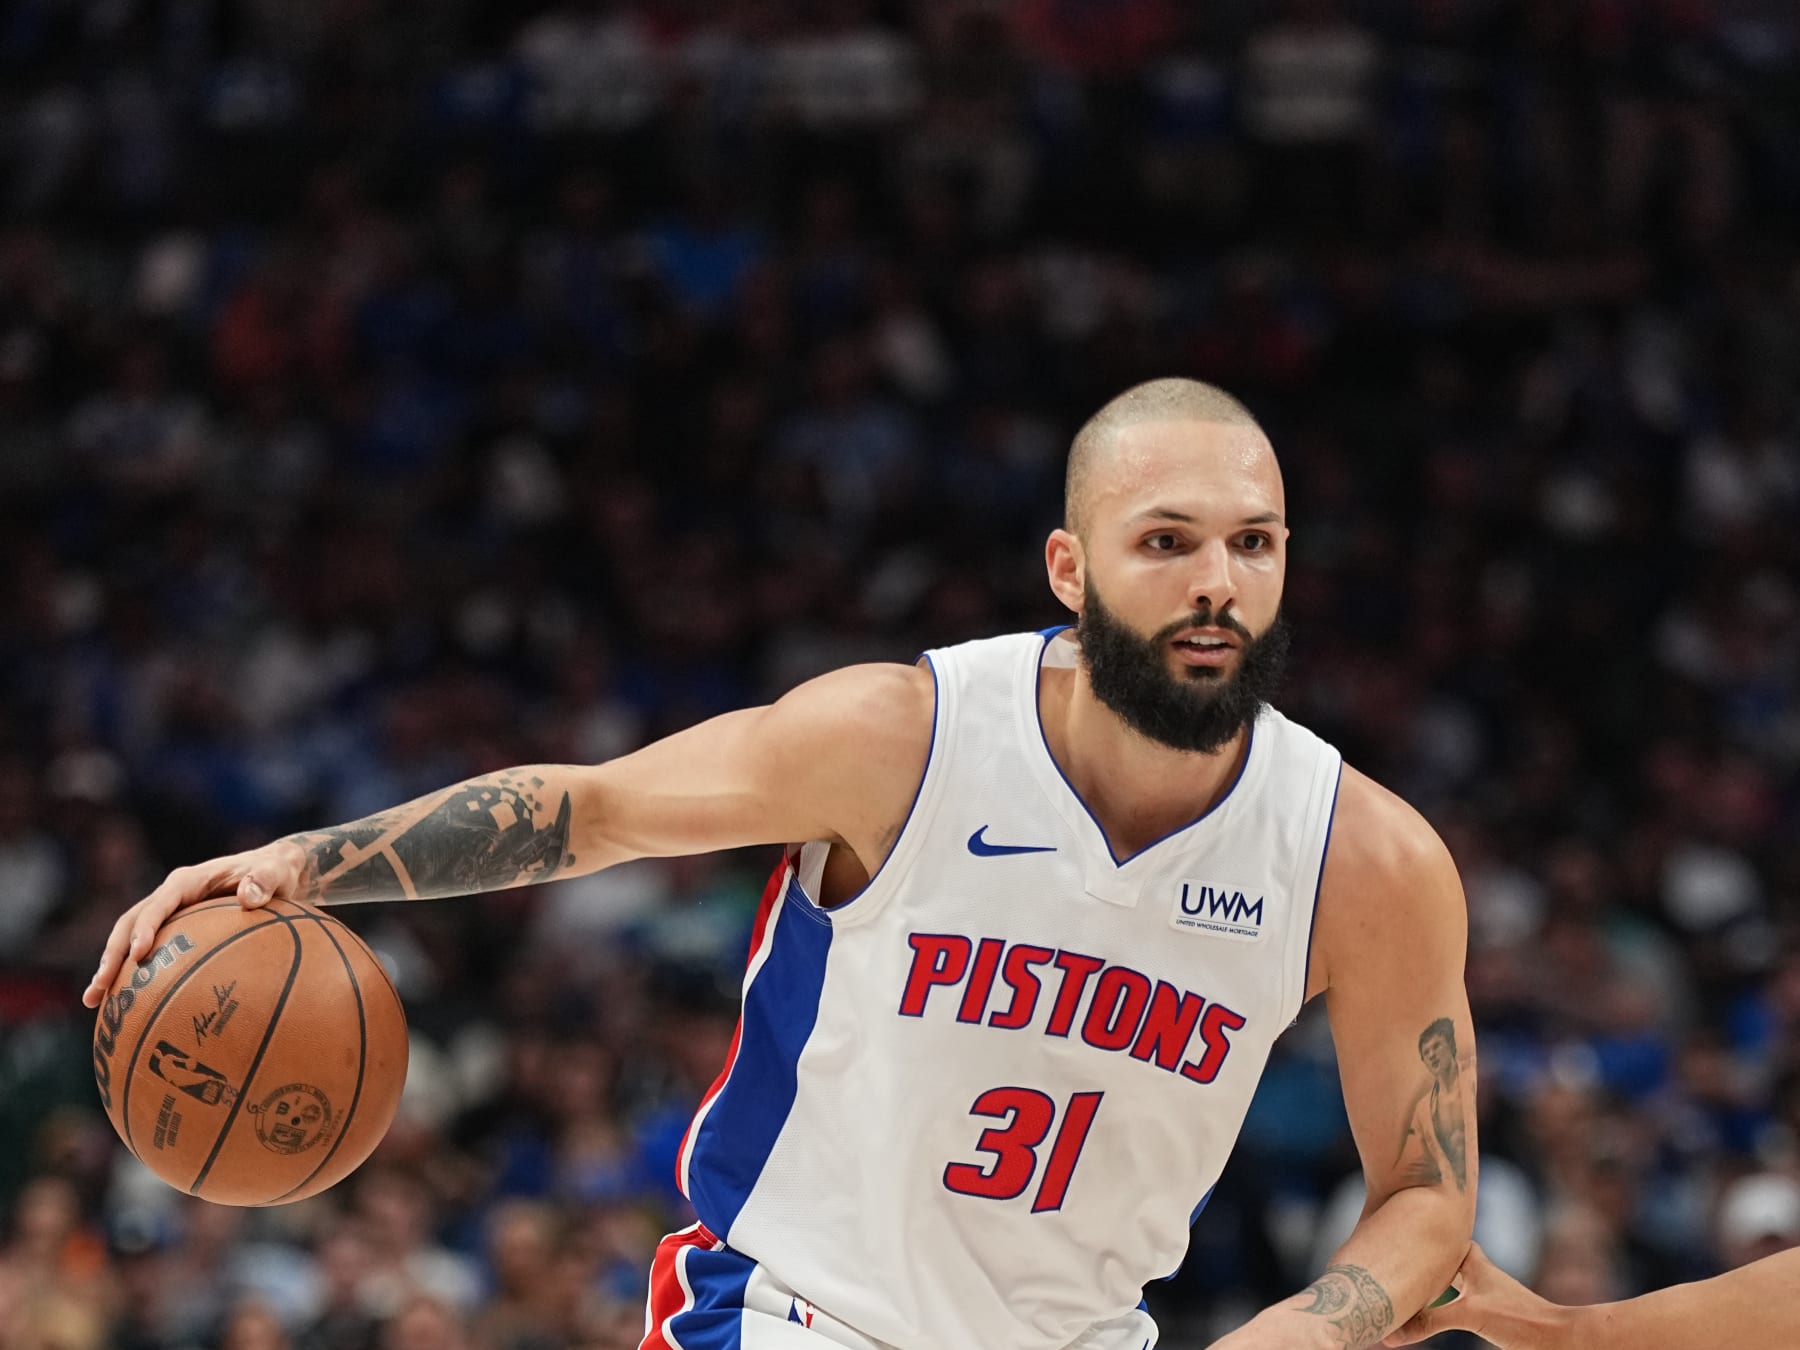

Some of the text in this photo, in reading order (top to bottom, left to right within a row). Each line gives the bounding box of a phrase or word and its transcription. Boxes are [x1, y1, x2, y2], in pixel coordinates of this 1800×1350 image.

[1175, 919, 1259, 938] UNITED WHOLESALE MORTGAGE
[1181, 883, 1263, 926] UWM
[898, 932, 1247, 1085] PISTONS
[942, 1086, 1105, 1214] 31
